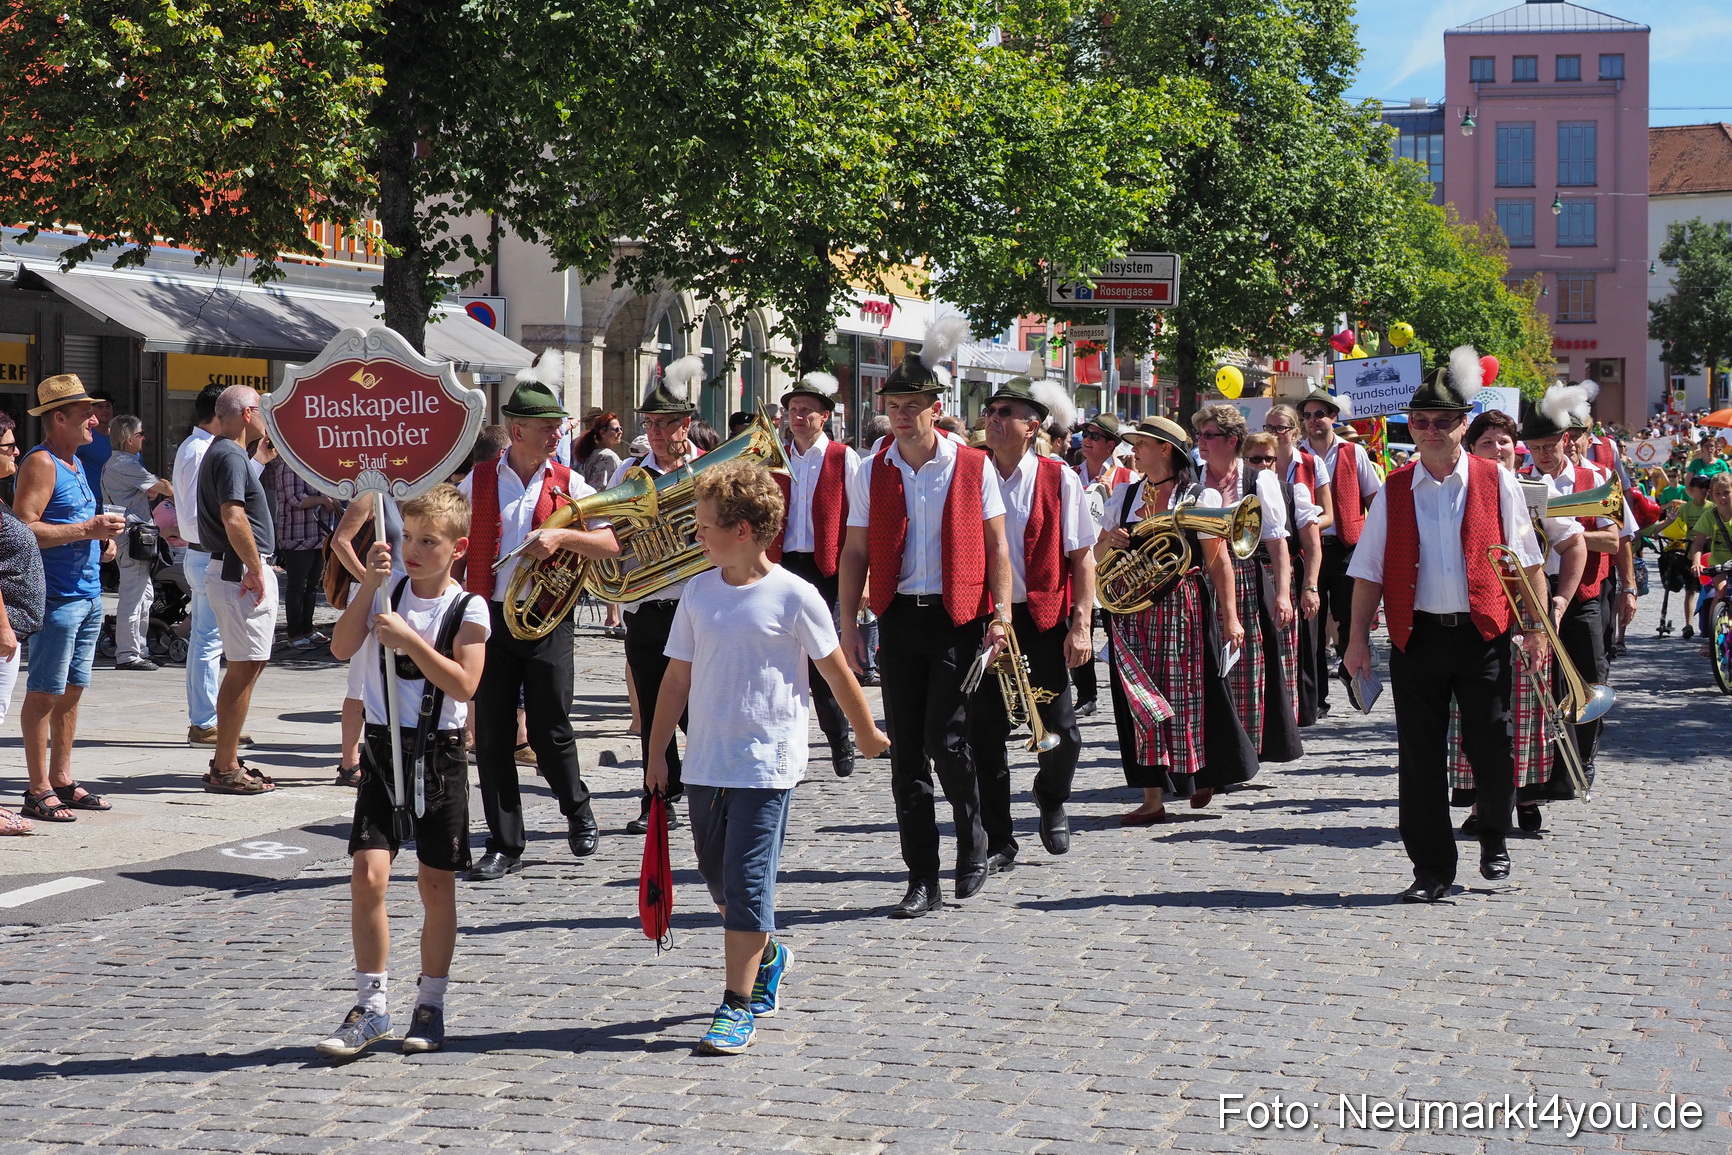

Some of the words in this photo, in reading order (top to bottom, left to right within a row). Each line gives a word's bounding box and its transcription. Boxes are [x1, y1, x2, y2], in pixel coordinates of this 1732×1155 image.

[1100, 285, 1153, 299] Rosengasse
[1069, 328, 1105, 339] Rosengasse
[303, 390, 440, 422] Blaskapelle
[316, 421, 430, 449] Dirnhofer
[358, 452, 388, 470] Stauf
